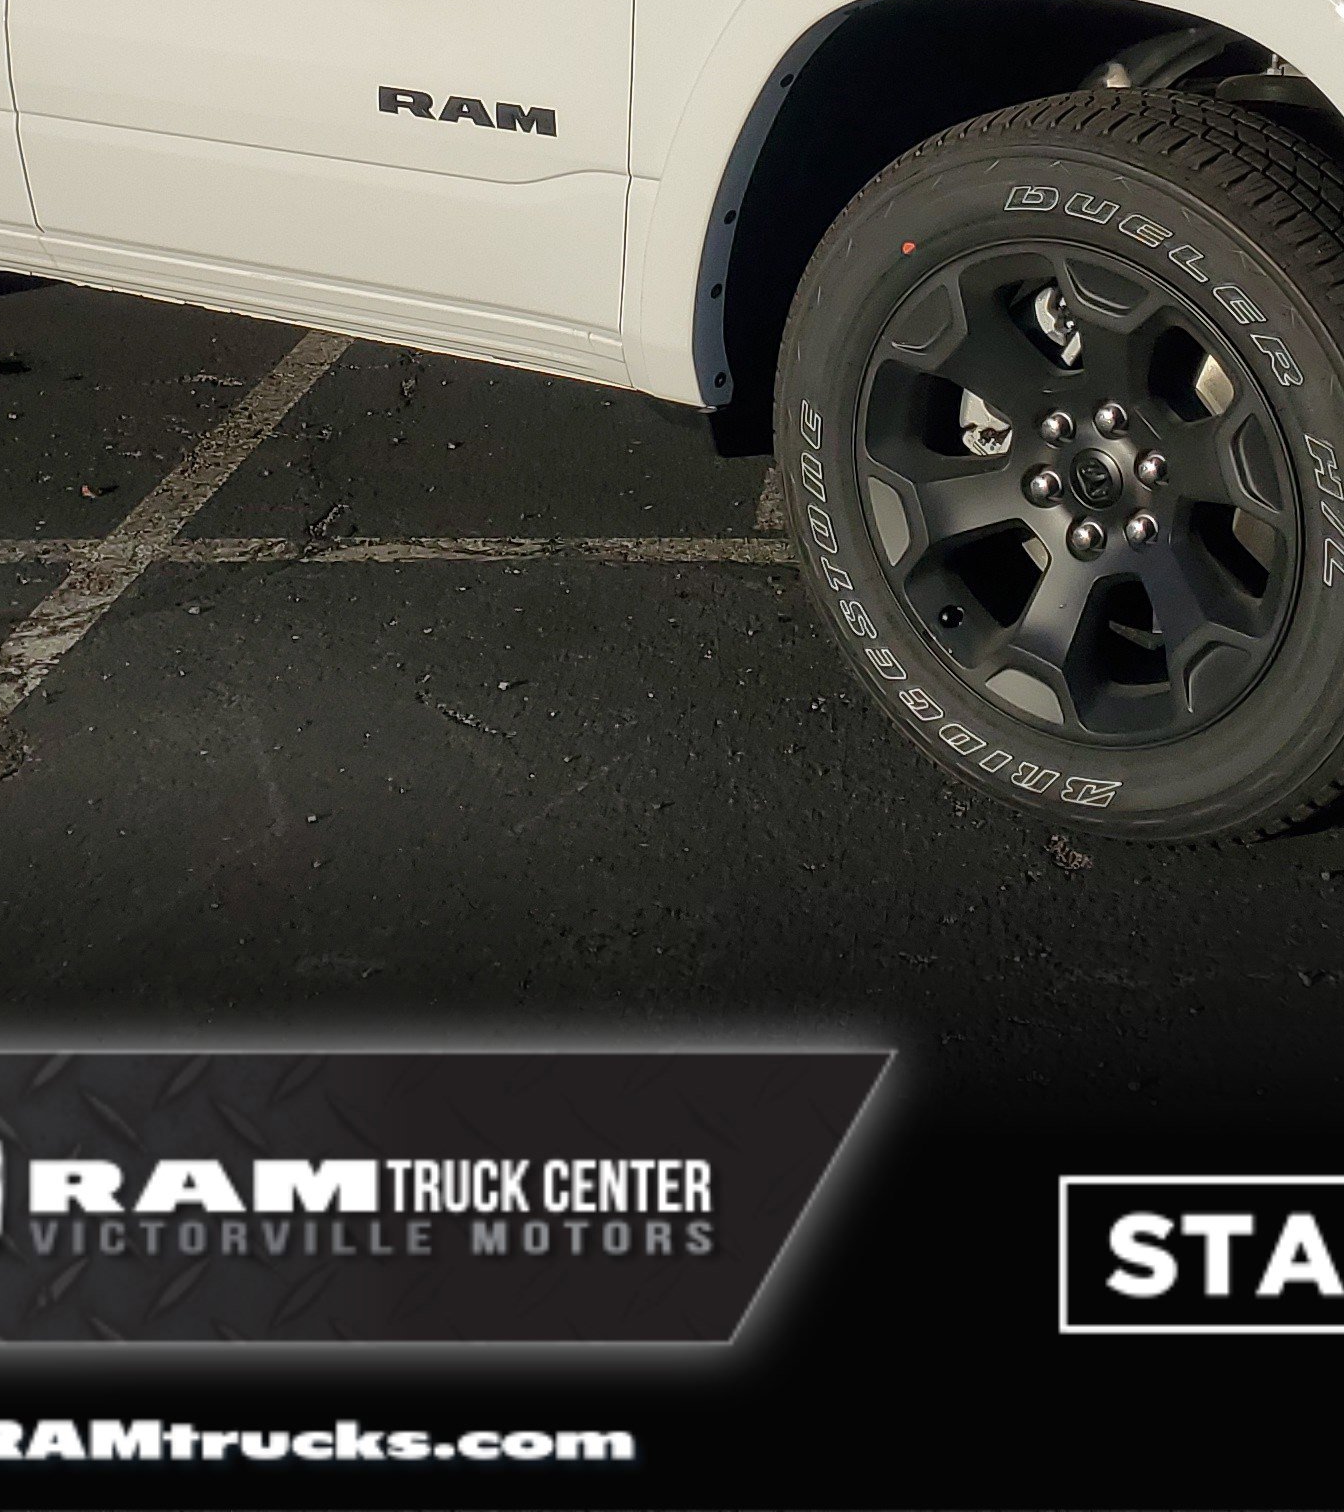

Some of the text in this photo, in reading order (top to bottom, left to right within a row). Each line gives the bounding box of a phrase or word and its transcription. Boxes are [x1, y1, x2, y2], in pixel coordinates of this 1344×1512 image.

[378, 85, 558, 138] RAM
[1003, 184, 1306, 387] DUELER
[800, 399, 1124, 809] BRIDGESTONE
